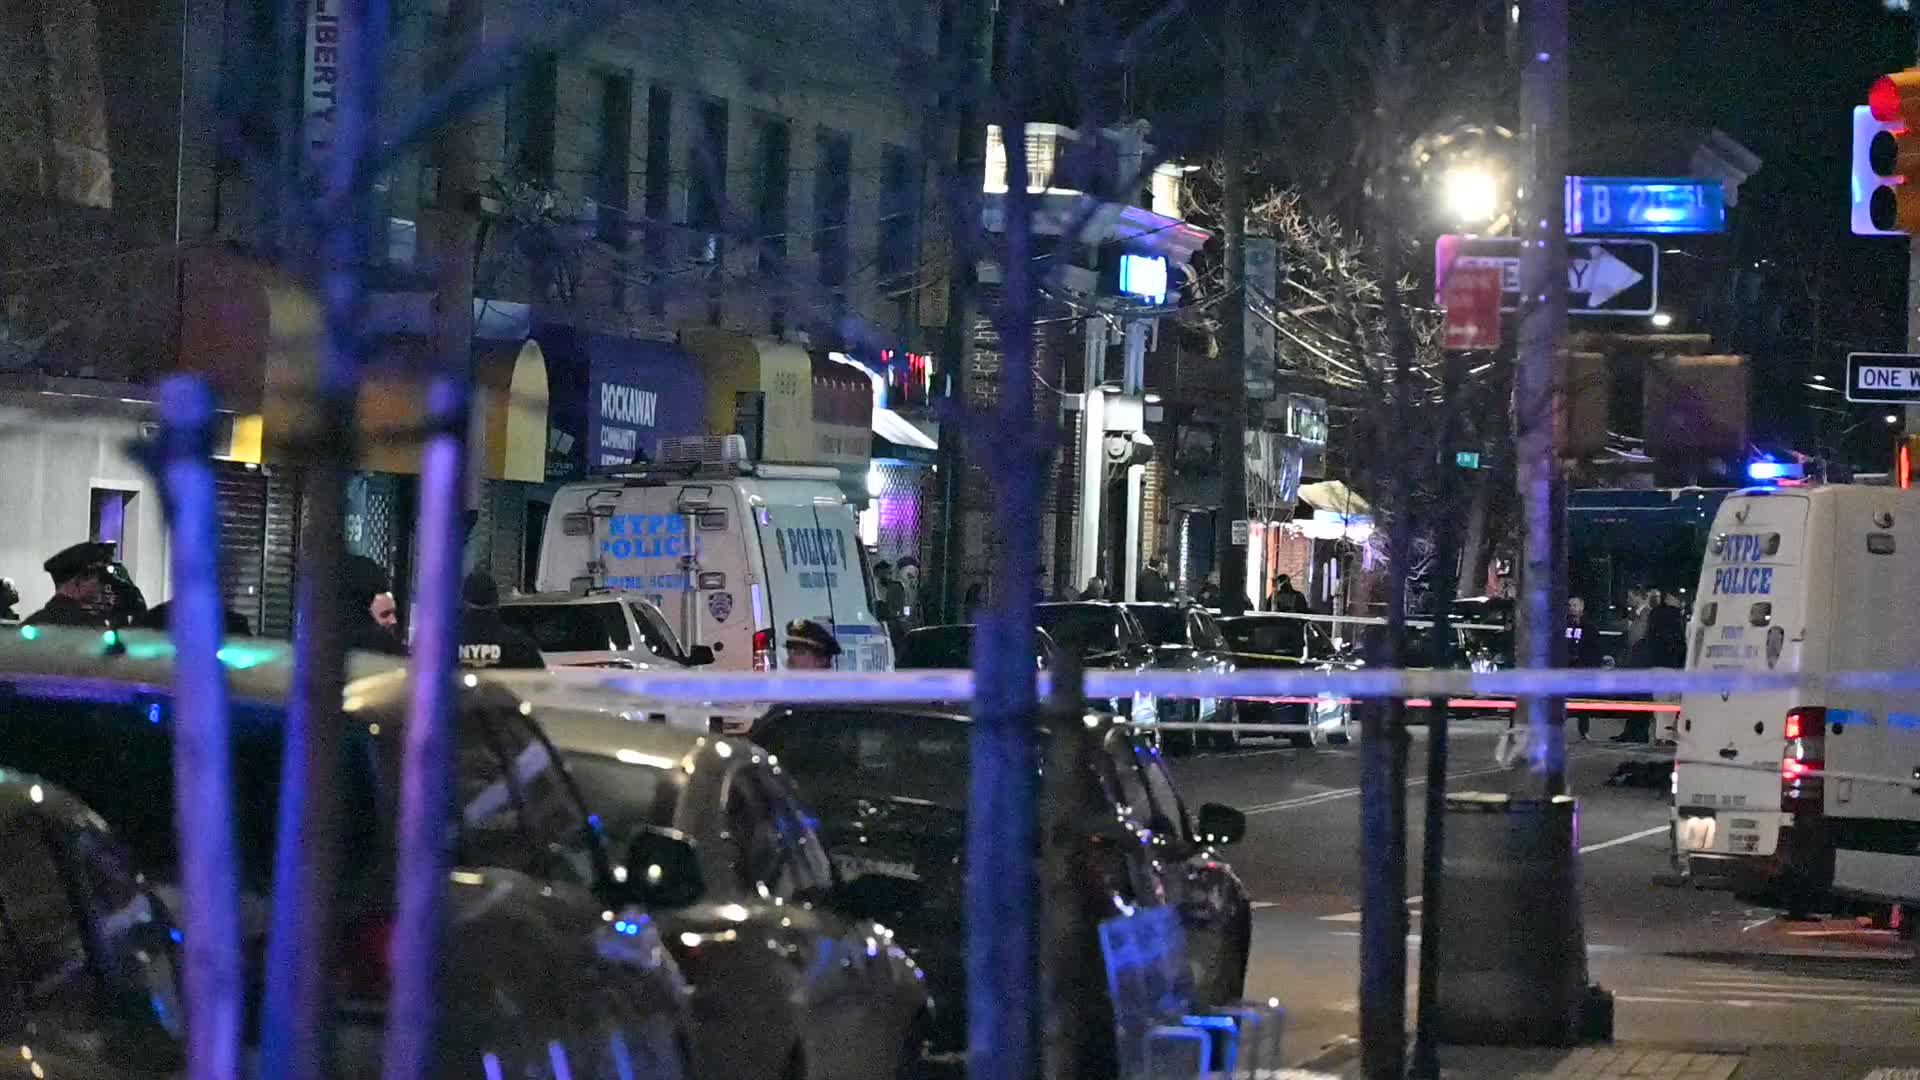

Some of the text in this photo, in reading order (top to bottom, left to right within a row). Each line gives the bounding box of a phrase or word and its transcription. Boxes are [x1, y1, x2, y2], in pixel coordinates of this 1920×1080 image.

[1593, 185, 1611, 224] B
[1864, 369, 1902, 387] ONE
[601, 382, 657, 428] ROCKAWAY
[601, 537, 704, 559] OLIC
[787, 528, 838, 565] POLICE
[1713, 567, 1773, 594] POLICE
[459, 644, 501, 659] NYPD
